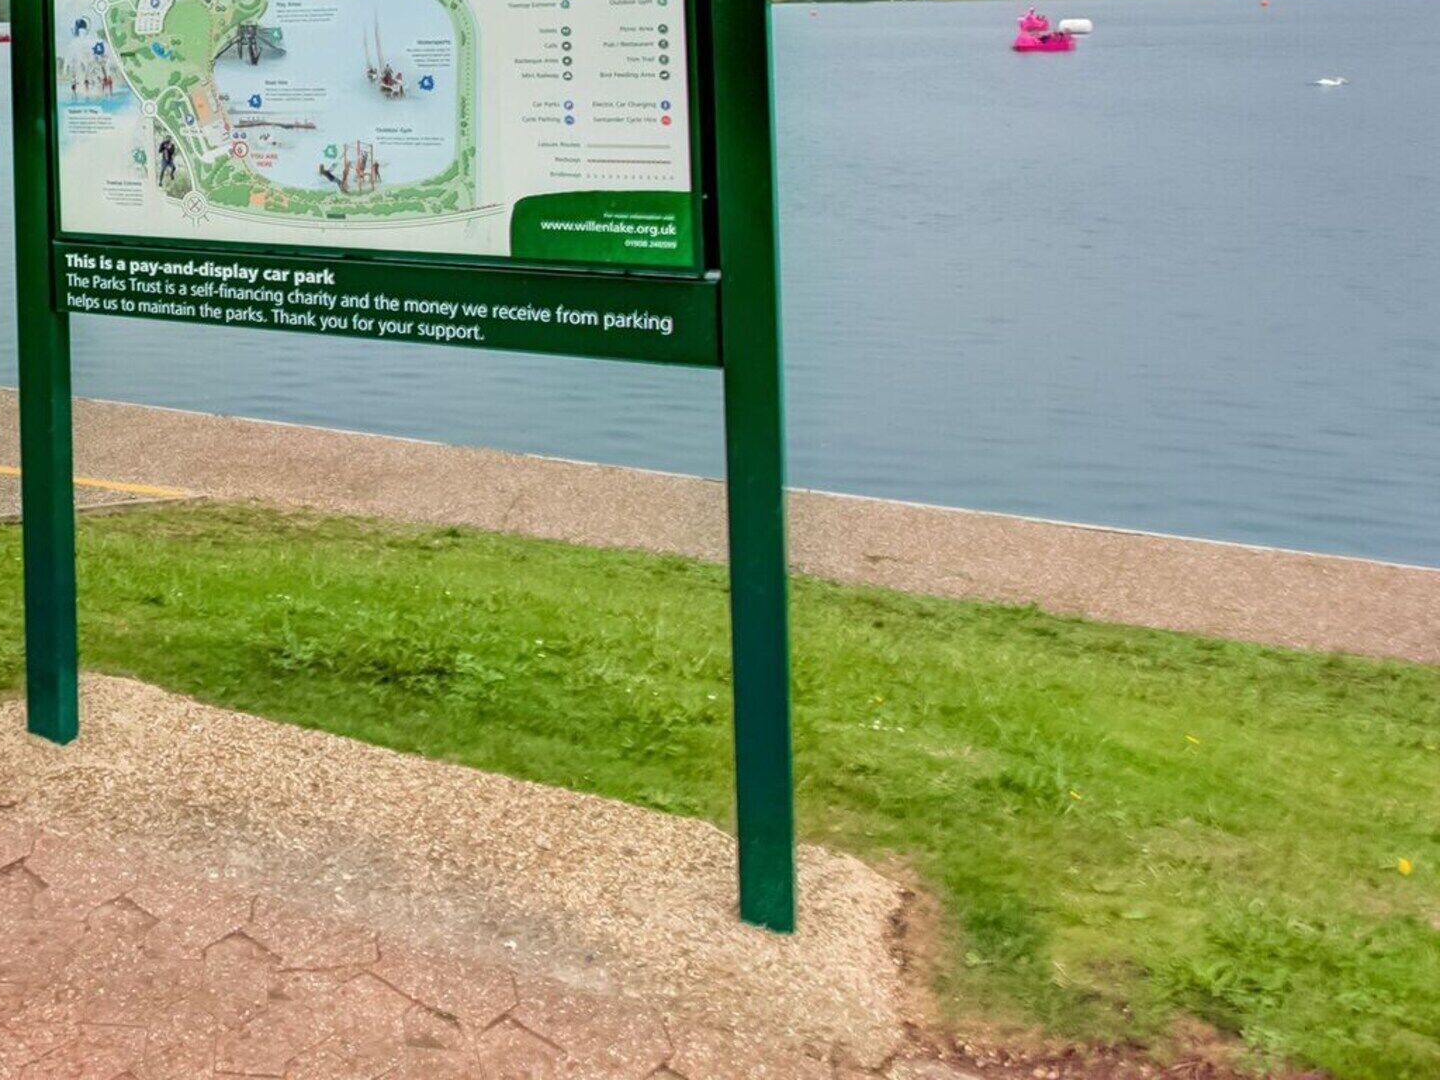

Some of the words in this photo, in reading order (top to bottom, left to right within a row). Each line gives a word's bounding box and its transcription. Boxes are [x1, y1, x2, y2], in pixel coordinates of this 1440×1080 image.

[540, 220, 676, 237] www.willenlake.org.uk
[65, 254, 96, 269] This
[99, 255, 112, 270] is
[116, 259, 126, 271] a
[129, 260, 259, 283] pay-and-display
[263, 269, 290, 282] car
[293, 268, 335, 286] park
[66, 273, 89, 288] The
[92, 275, 127, 291] Parks
[128, 277, 162, 293] Trust
[165, 279, 175, 295] is
[178, 284, 187, 296] a
[190, 281, 284, 307] self-financing
[287, 287, 337, 310] charity
[340, 292, 370, 309] and
[374, 292, 400, 312] the
[404, 299, 459, 319] money
[462, 303, 488, 318] we
[492, 303, 551, 323] receive
[555, 303, 599, 326] from
[603, 309, 674, 335] parking
[67, 292, 100, 311] helps
[103, 298, 118, 311] us
[121, 298, 135, 312] to
[138, 299, 195, 316] maintain
[199, 302, 222, 318] the
[225, 306, 268, 324] parks.
[271, 308, 316, 327] Thank
[319, 315, 349, 331] you
[352, 313, 375, 331] for
[377, 320, 414, 336] your
[417, 321, 485, 341] support.
